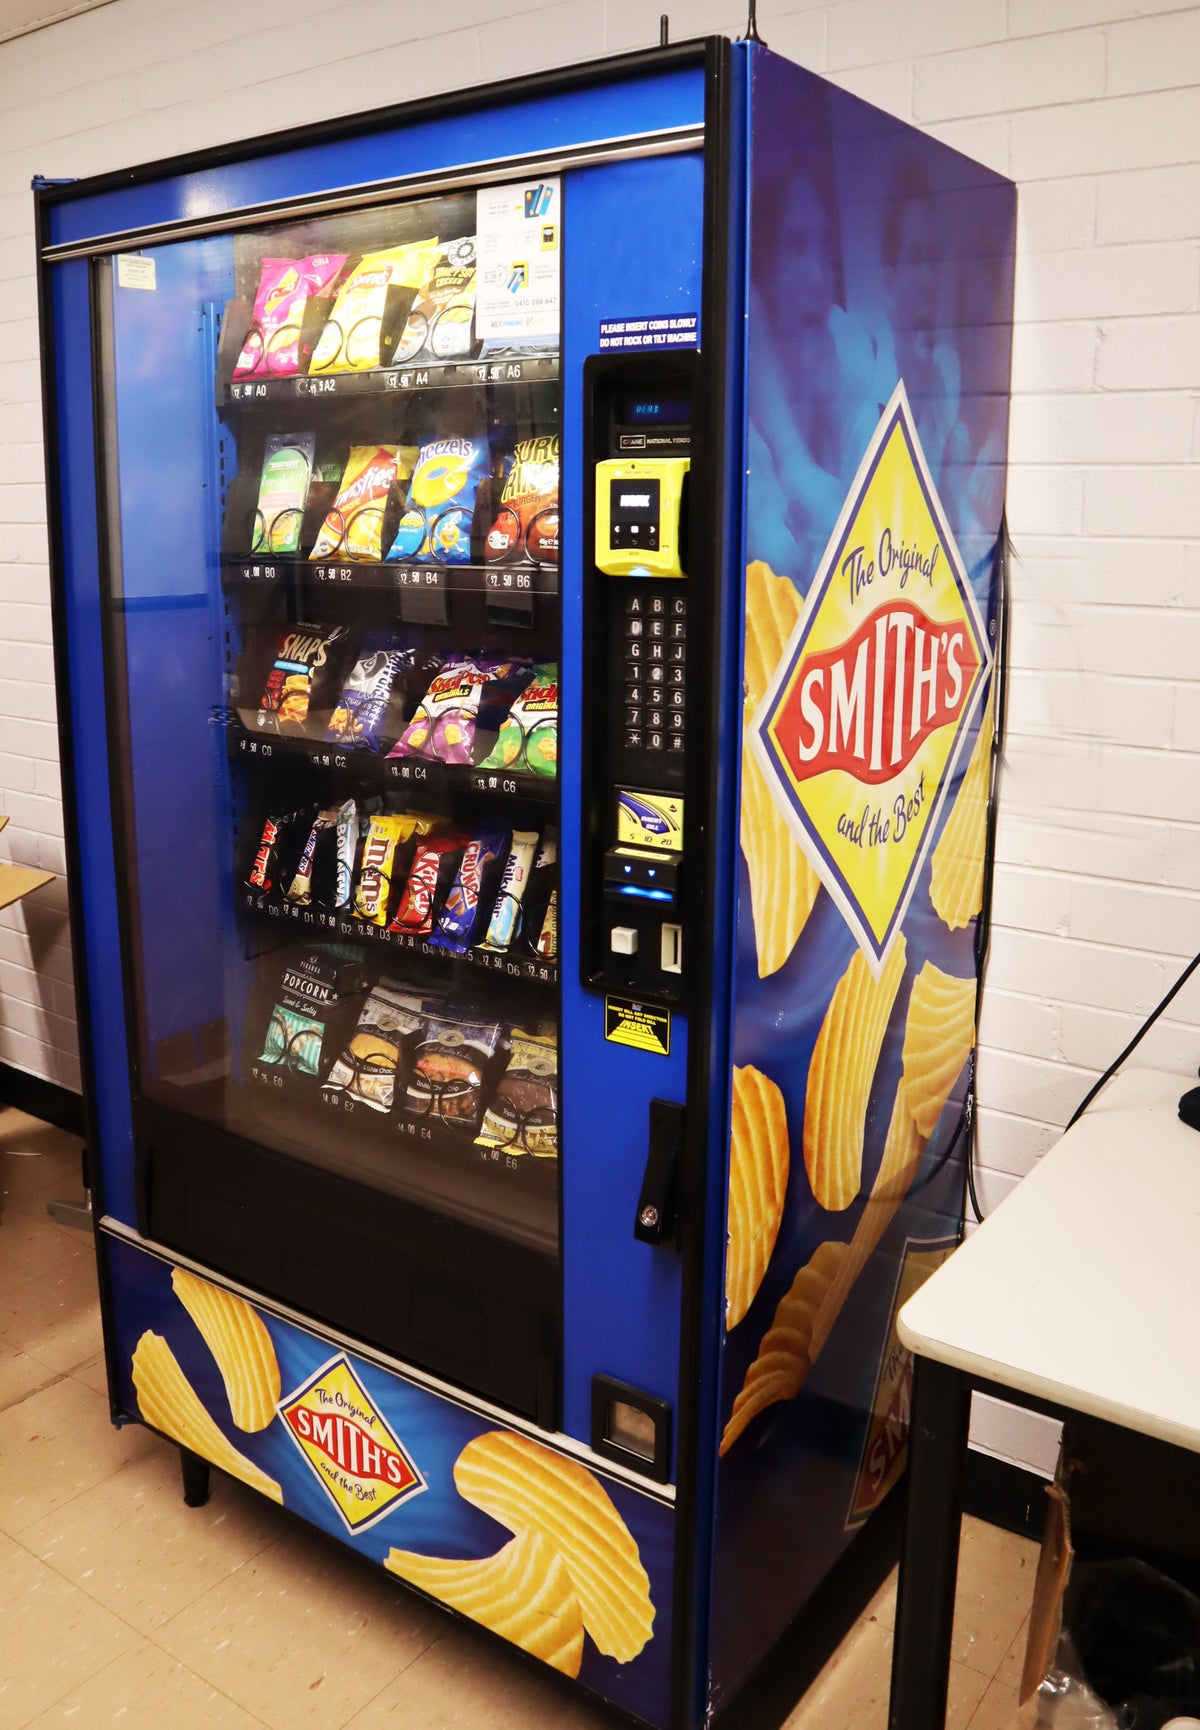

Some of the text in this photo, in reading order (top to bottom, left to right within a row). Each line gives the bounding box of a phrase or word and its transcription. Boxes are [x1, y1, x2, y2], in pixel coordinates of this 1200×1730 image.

[436, 278, 463, 287] CHICKEN
[601, 317, 697, 334] PLEASE INSERT COINS SLOWLY
[600, 332, 697, 348] DO NOT ROCK OR TILT MACHINE
[416, 372, 428, 385] A4
[507, 365, 521, 379] A6
[256, 385, 266, 397] A0
[324, 379, 336, 392] A2
[264, 567, 275, 578] B0
[842, 527, 940, 606] The Original
[340, 569, 352, 581] B2
[400, 572, 438, 584] $2.50 B4
[491, 574, 530, 588] $2.50 B6
[632, 598, 683, 613] A B C
[631, 621, 682, 636] D E F
[278, 633, 331, 667] SNAPS
[632, 643, 682, 659] G H J
[633, 666, 682, 682] 1 2 3
[435, 688, 470, 702] ORIGINALS
[631, 688, 682, 704] 4 5 6
[798, 611, 964, 770] SMITH'S
[631, 710, 681, 727] 7 8 9
[653, 734, 681, 749] 0 #
[262, 744, 272, 757] C0
[335, 755, 347, 768] C2
[415, 767, 427, 779] C4
[503, 780, 516, 793] C6
[837, 771, 927, 849] and the Best
[644, 835, 653, 843] 10
[660, 838, 673, 846] 20
[461, 842, 480, 908] CRUNCH
[268, 904, 279, 917] D0
[304, 912, 314, 924] D1
[341, 922, 352, 935] D2
[358, 924, 391, 941] $2.50 D3
[422, 943, 434, 955] D4
[482, 954, 520, 976] $2.50 D6
[528, 964, 548, 980] $2.50
[283, 972, 330, 1001] POPCORN
[301, 1003, 317, 1017] Salty
[619, 1019, 654, 1035] INSERT
[273, 1076, 283, 1087] E0
[416, 1080, 431, 1090] Doubl
[344, 1101, 354, 1113] E2
[421, 1127, 431, 1140] E4
[506, 1156, 518, 1170] E6
[315, 1388, 377, 1429] The Original
[297, 1408, 402, 1484] SMITH'S
[320, 1461, 377, 1502] and the Best
